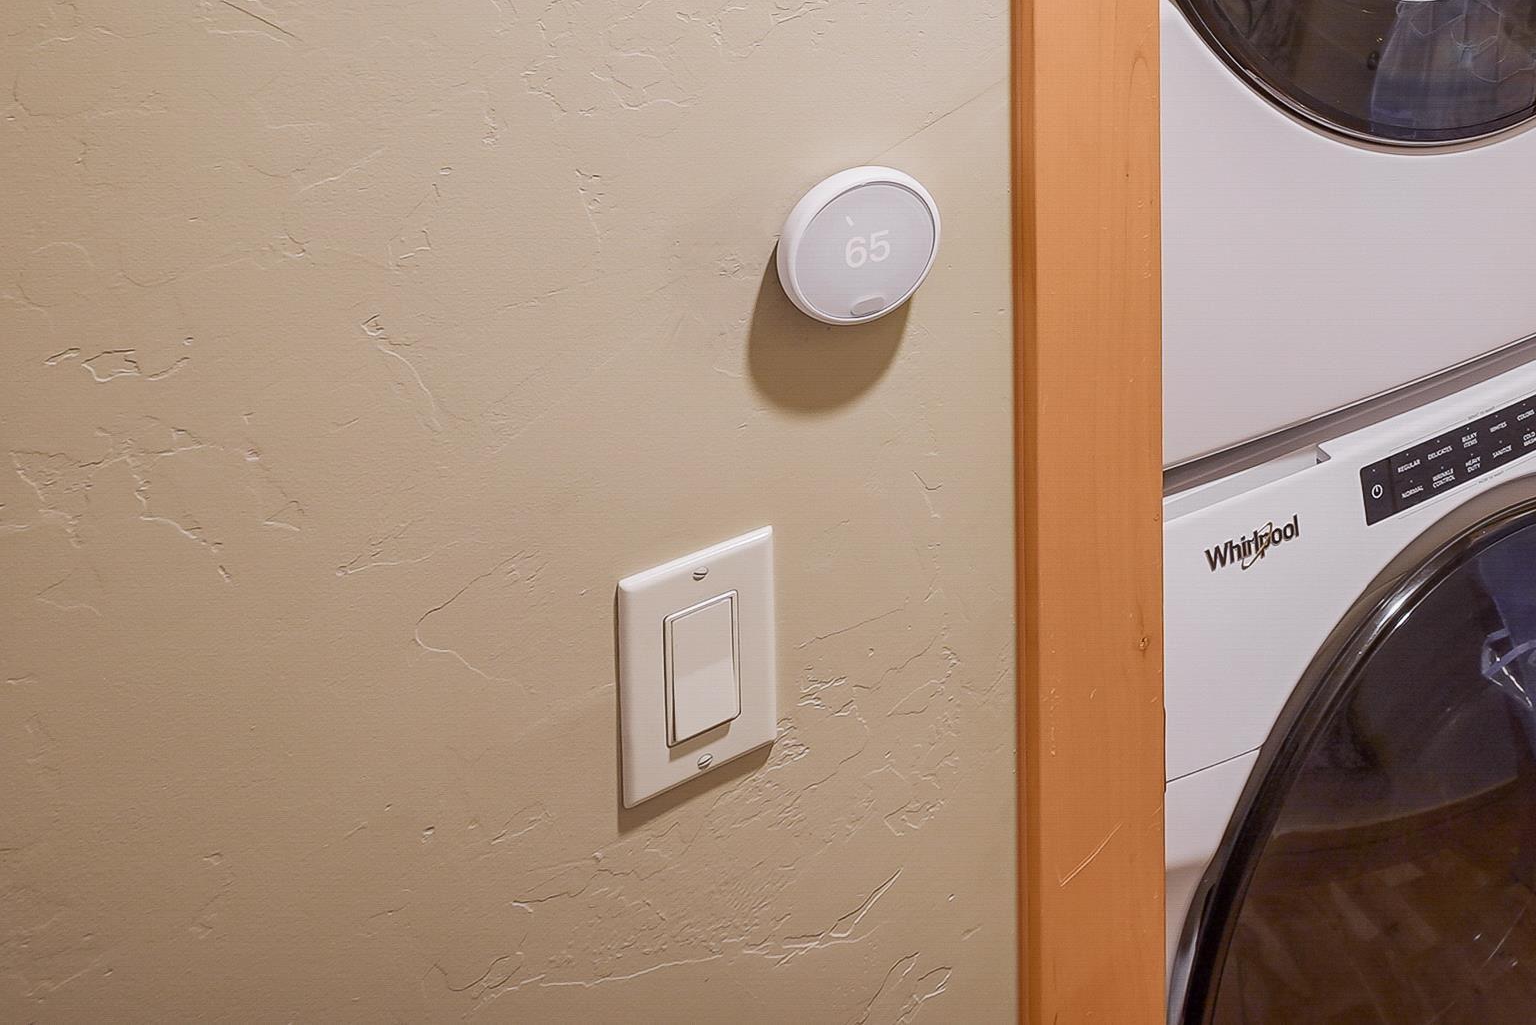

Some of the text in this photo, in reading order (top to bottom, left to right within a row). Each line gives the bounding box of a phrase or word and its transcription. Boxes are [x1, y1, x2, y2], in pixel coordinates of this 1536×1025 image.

[845, 229, 891, 269] 65
[1427, 445, 1453, 461] DELICATES
[1397, 458, 1421, 473] REGULAR
[1401, 485, 1424, 499] NORMAL
[1204, 514, 1300, 572] Whirlpool
